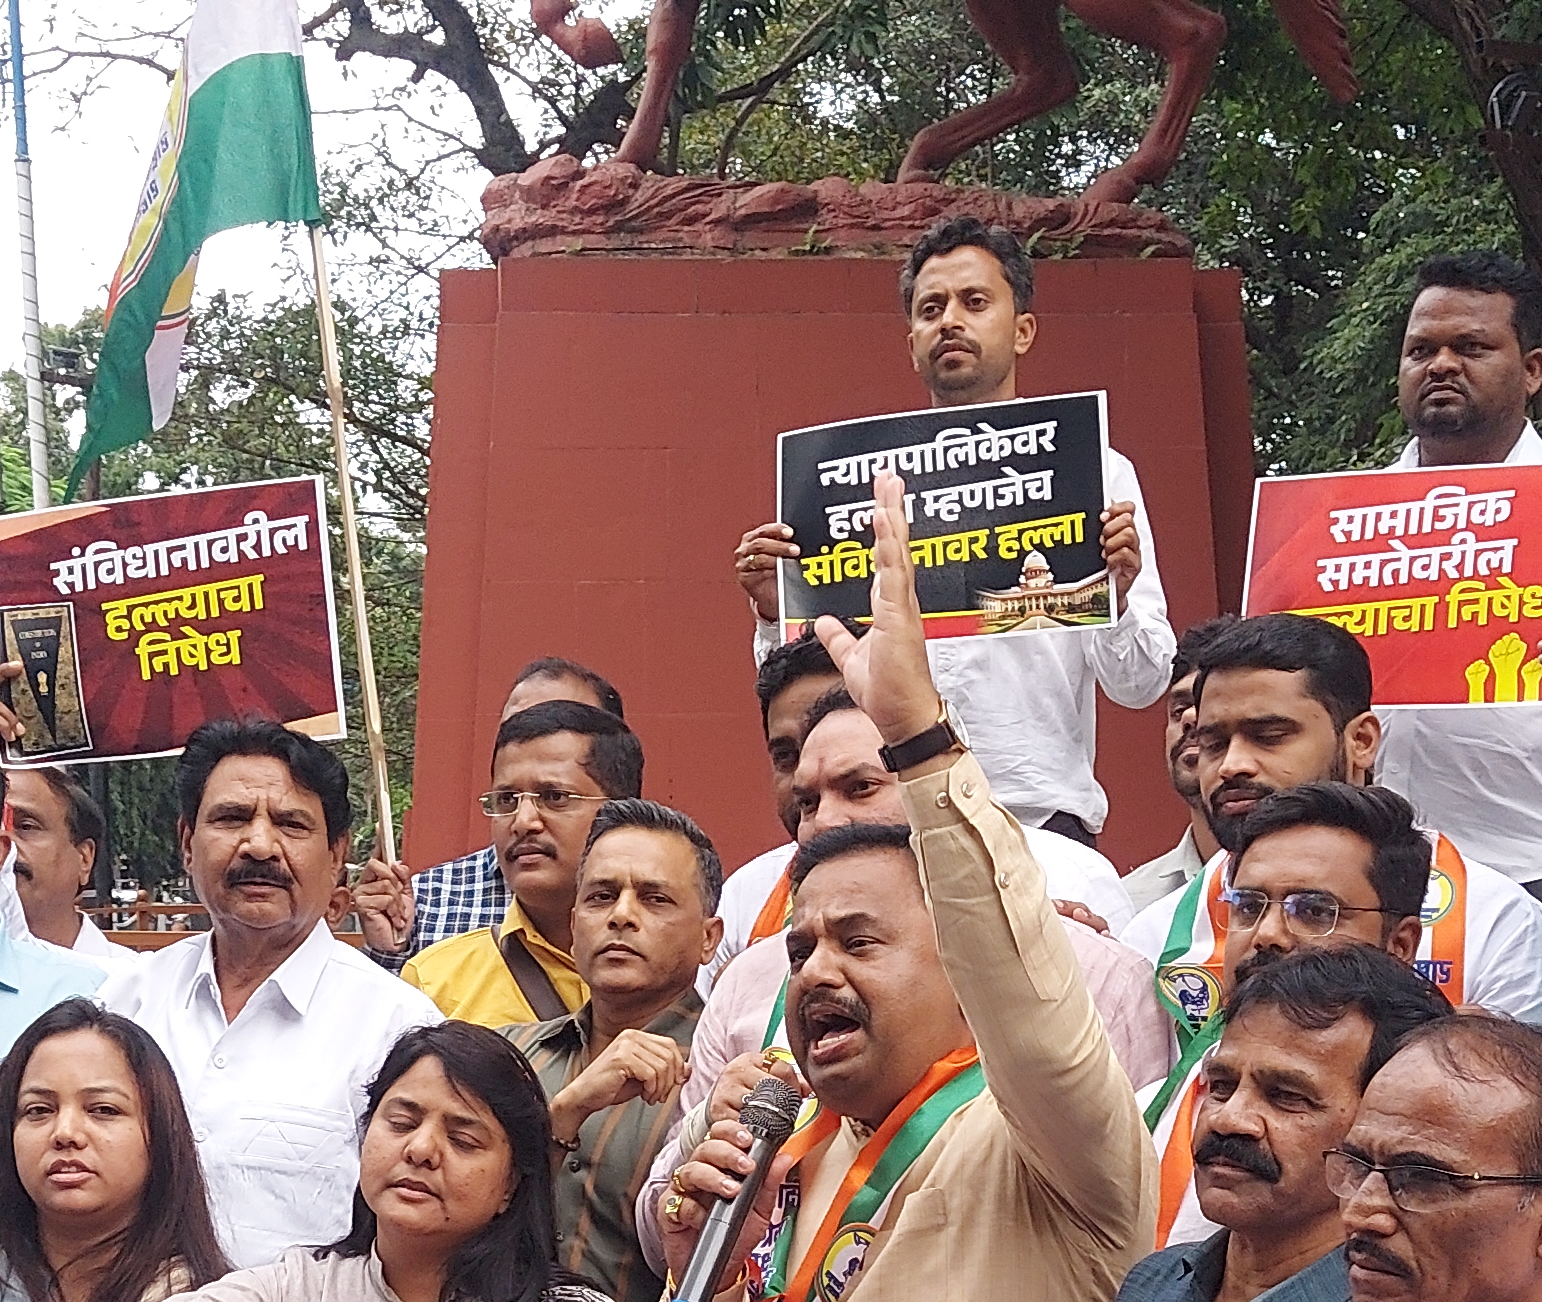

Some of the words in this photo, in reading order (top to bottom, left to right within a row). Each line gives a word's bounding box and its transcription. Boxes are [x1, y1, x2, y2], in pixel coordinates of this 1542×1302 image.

[920, 467, 1055, 522] म्हणजेच
[1329, 485, 1516, 543] सामाजिक
[50, 510, 310, 595] संविधानावरील
[996, 511, 1086, 560] हल्ला
[1316, 532, 1519, 593] समतेवरील
[101, 573, 264, 641] हल्ल्याचा
[135, 625, 242, 681] निषेध
